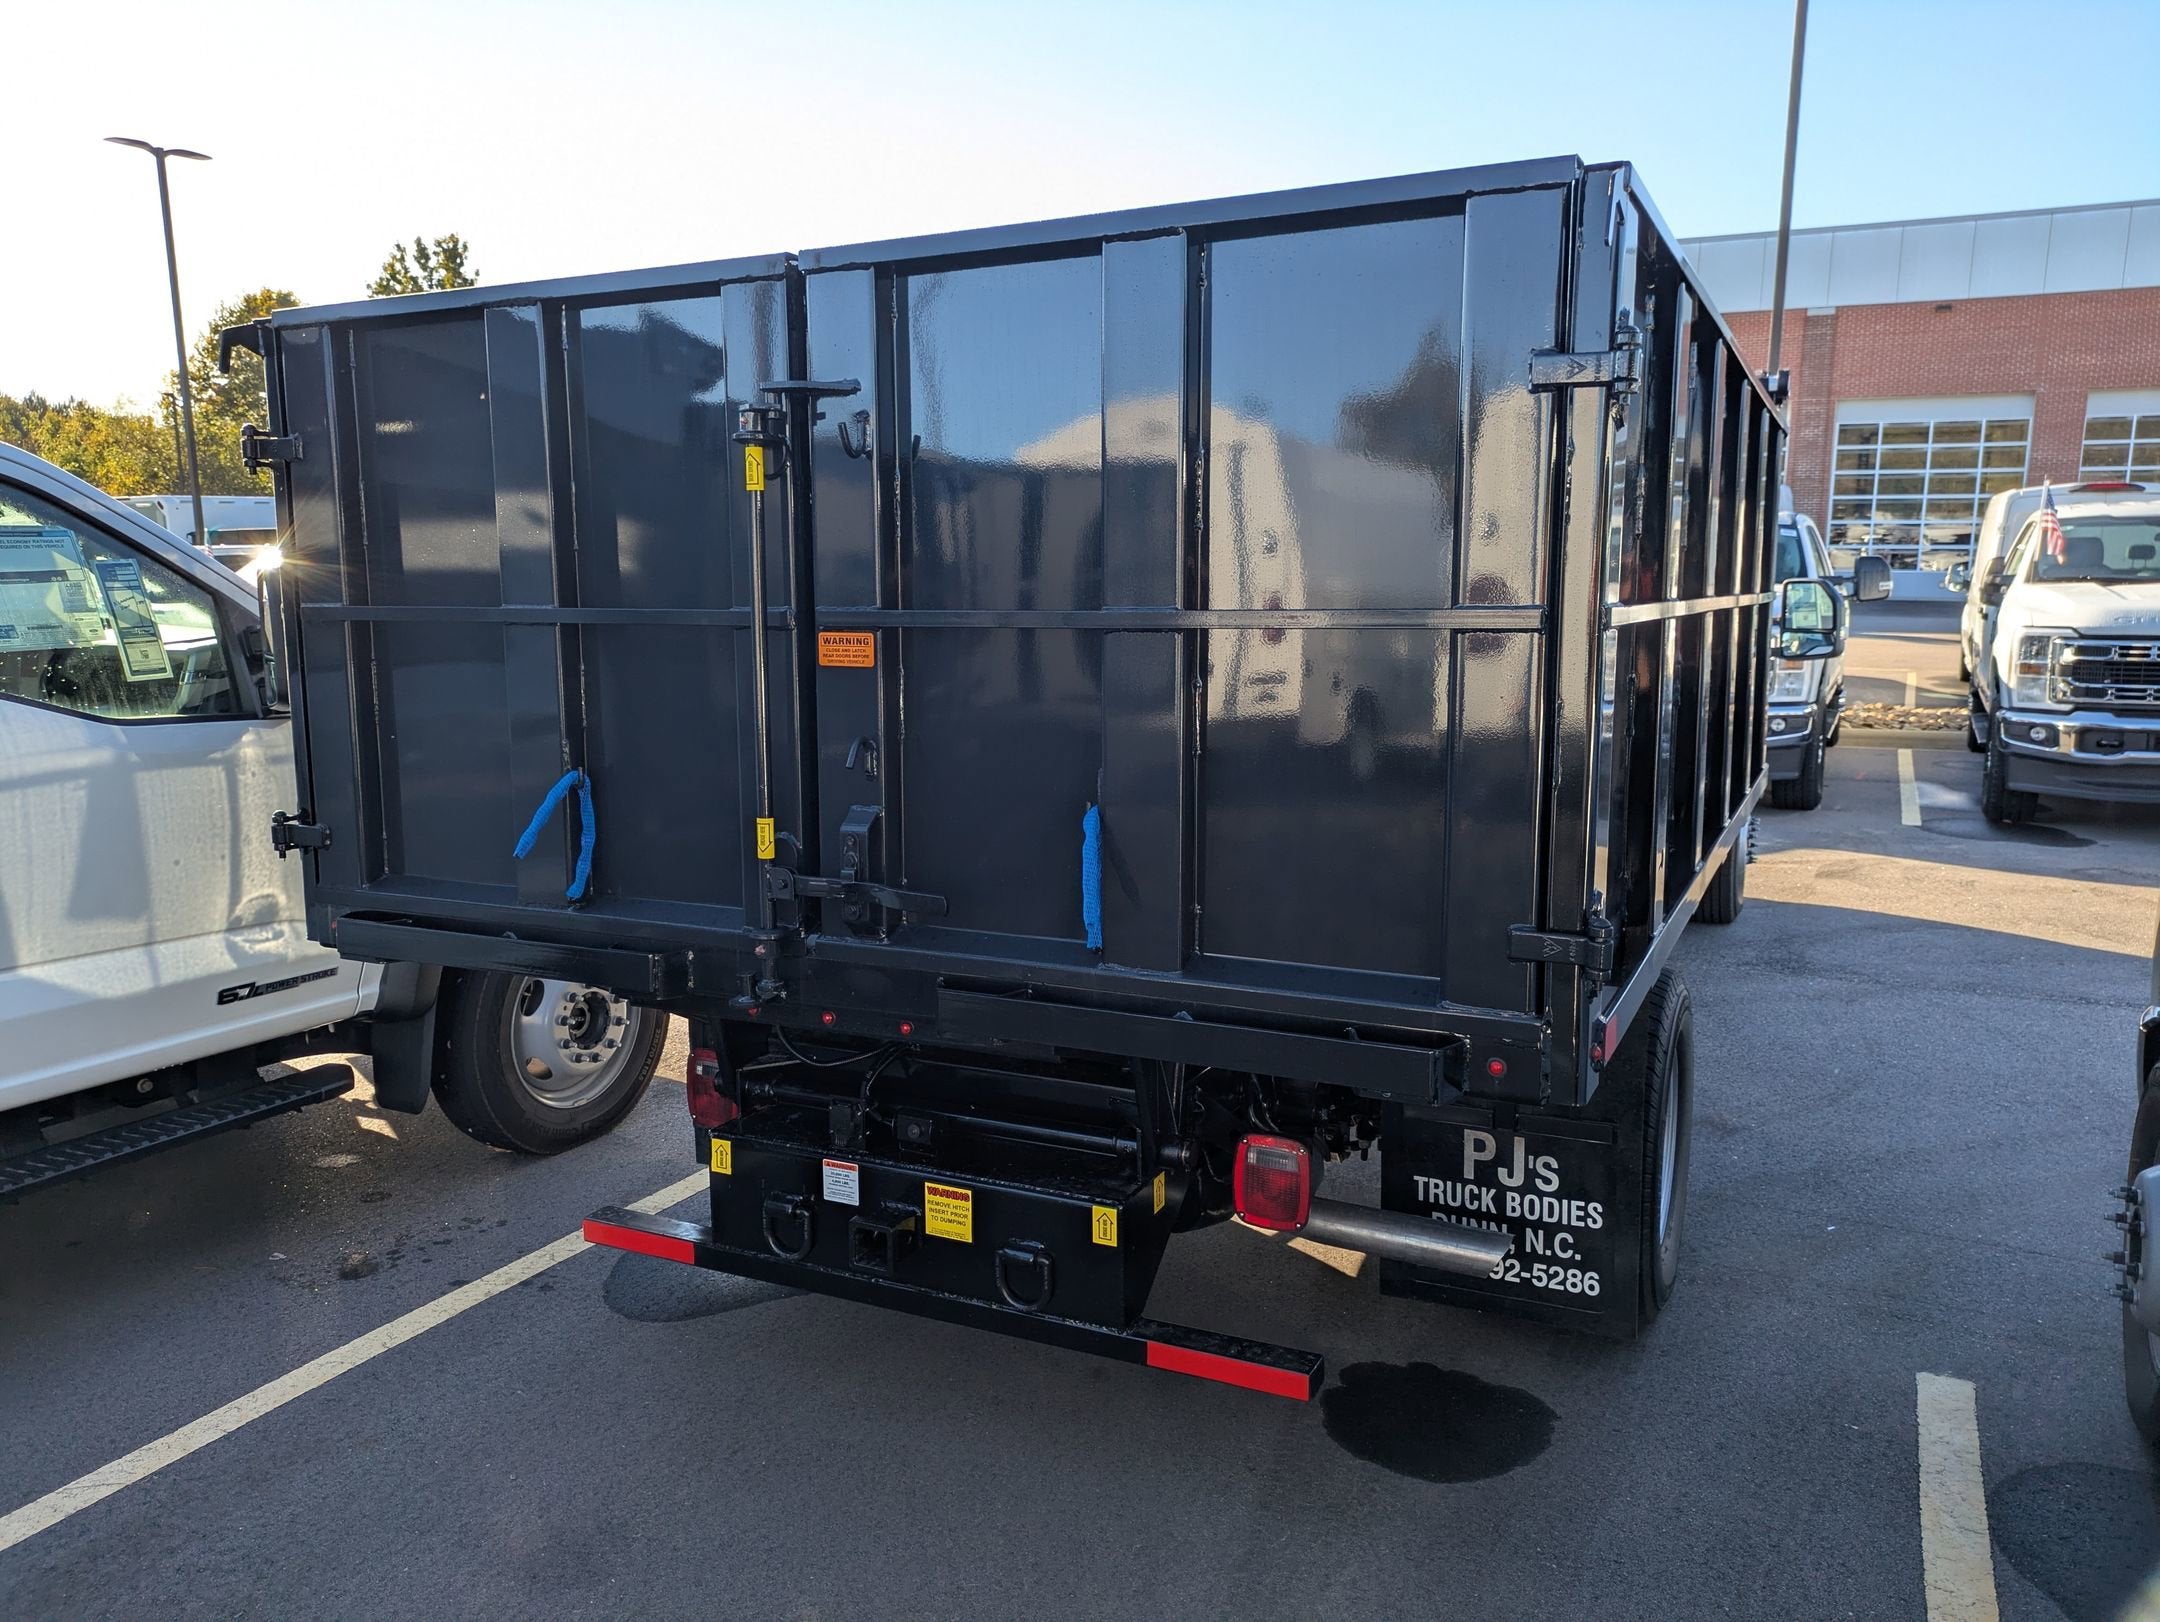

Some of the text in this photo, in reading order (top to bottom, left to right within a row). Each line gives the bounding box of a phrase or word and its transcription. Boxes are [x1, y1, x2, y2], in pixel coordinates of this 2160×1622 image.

[822, 637, 870, 646] WARNING
[265, 978, 299, 993] POWER
[300, 967, 339, 984] STROKE
[1463, 1128, 1560, 1192] PJ'S
[927, 1185, 970, 1202] WARNING
[1413, 1175, 1604, 1230] TRUCK BODIES
[927, 1199, 970, 1212] REMOVE HITCH
[928, 1207, 969, 1220] INSERT PRIOR
[940, 1217, 967, 1227] DUMPING
[1525, 1227, 1582, 1261] N.C.
[1488, 1258, 1601, 1297] 92-5286
